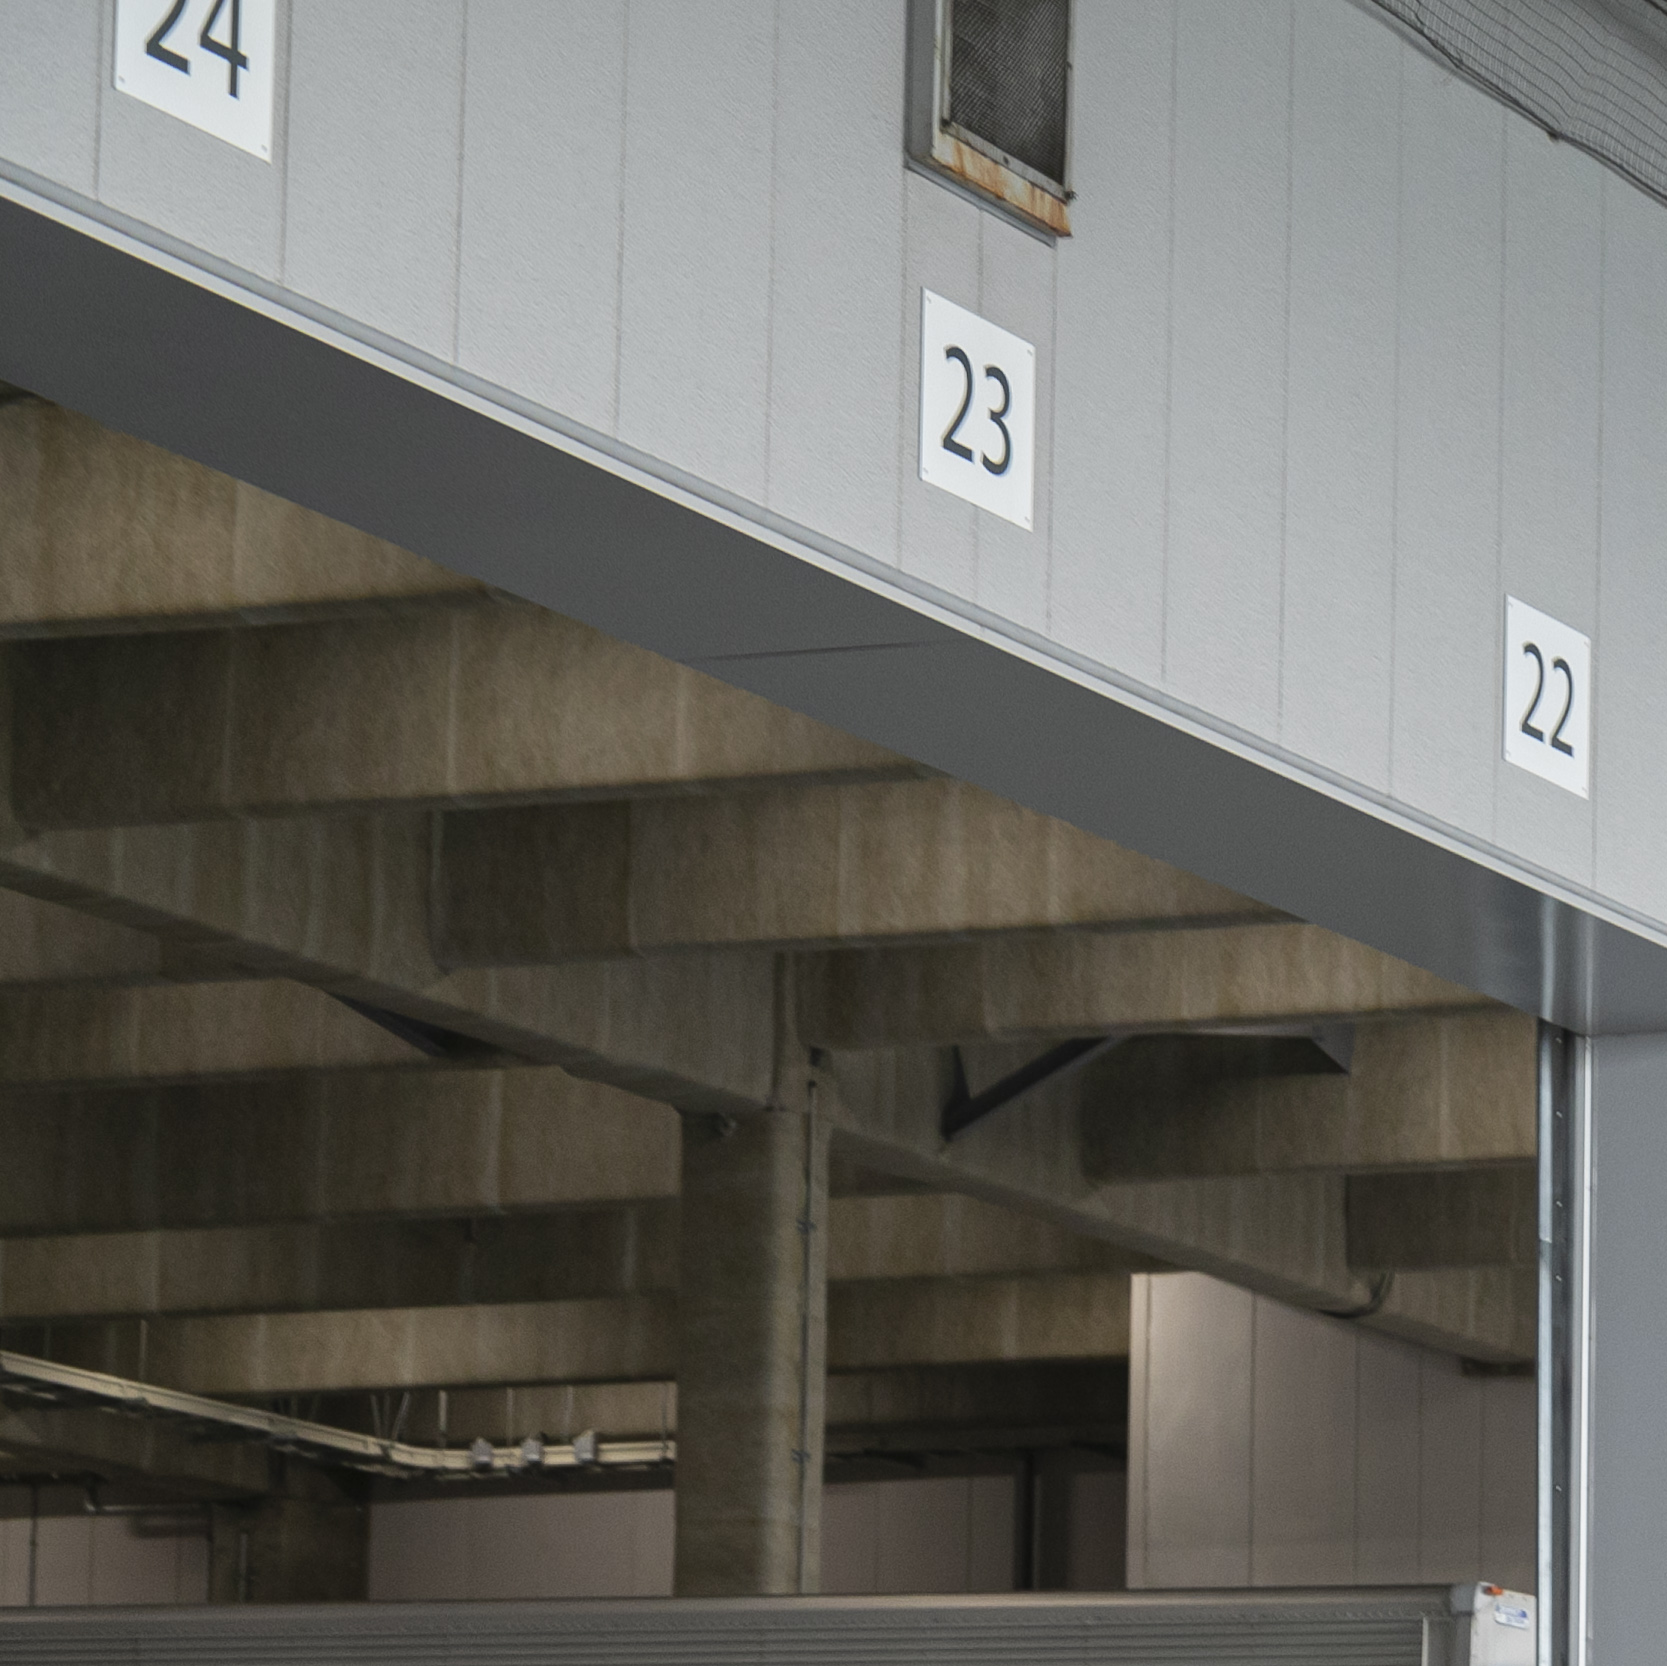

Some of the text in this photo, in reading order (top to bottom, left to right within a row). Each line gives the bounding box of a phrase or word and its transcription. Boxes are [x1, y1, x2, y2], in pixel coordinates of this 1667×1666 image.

[145, 0, 249, 100] 24
[943, 344, 1012, 476] 23
[1520, 641, 1574, 758] 22
